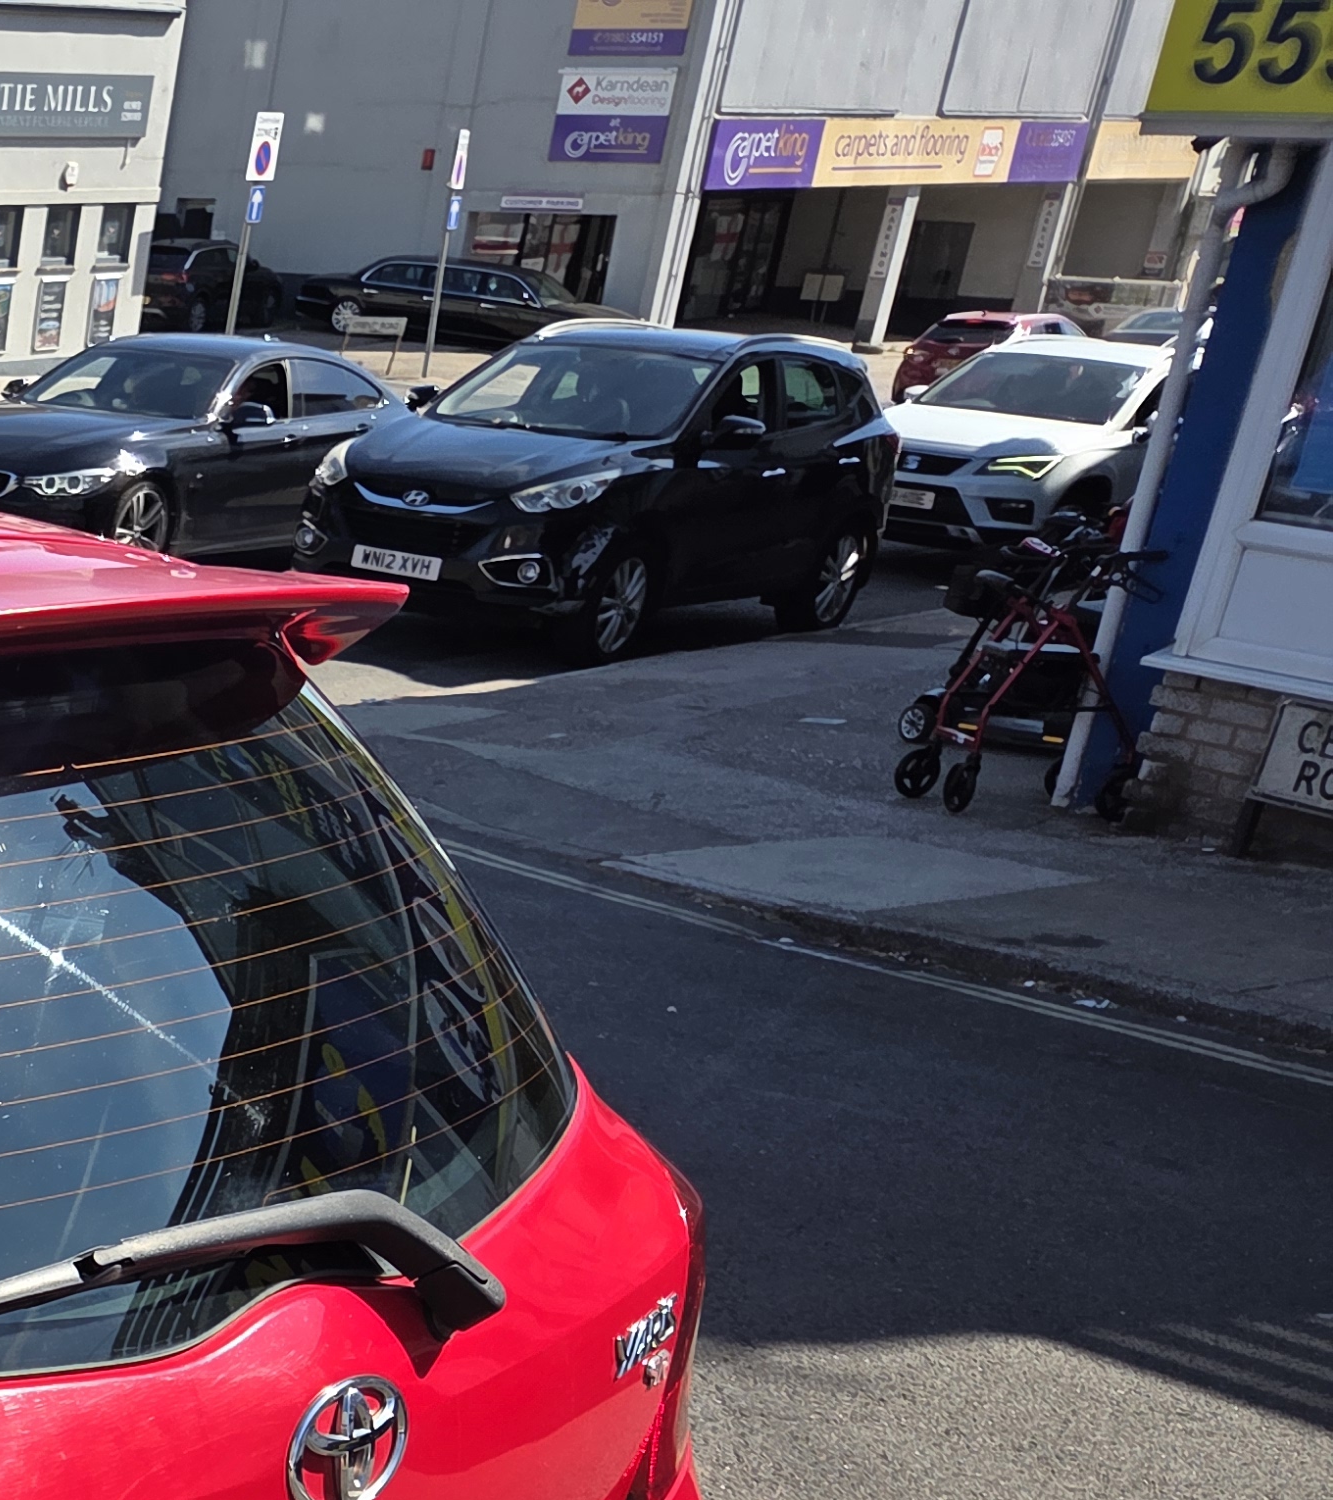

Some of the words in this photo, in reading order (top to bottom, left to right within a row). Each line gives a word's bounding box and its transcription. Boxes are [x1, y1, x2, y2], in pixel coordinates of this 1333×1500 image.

[1194, 0, 1333, 84] 55
[594, 76, 669, 92] Karndean
[43, 85, 114, 112] MILLS
[835, 128, 889, 164] carpets
[891, 126, 916, 157] and
[917, 125, 970, 164] flooring
[361, 548, 397, 570] WN12
[398, 555, 433, 576] XVH
